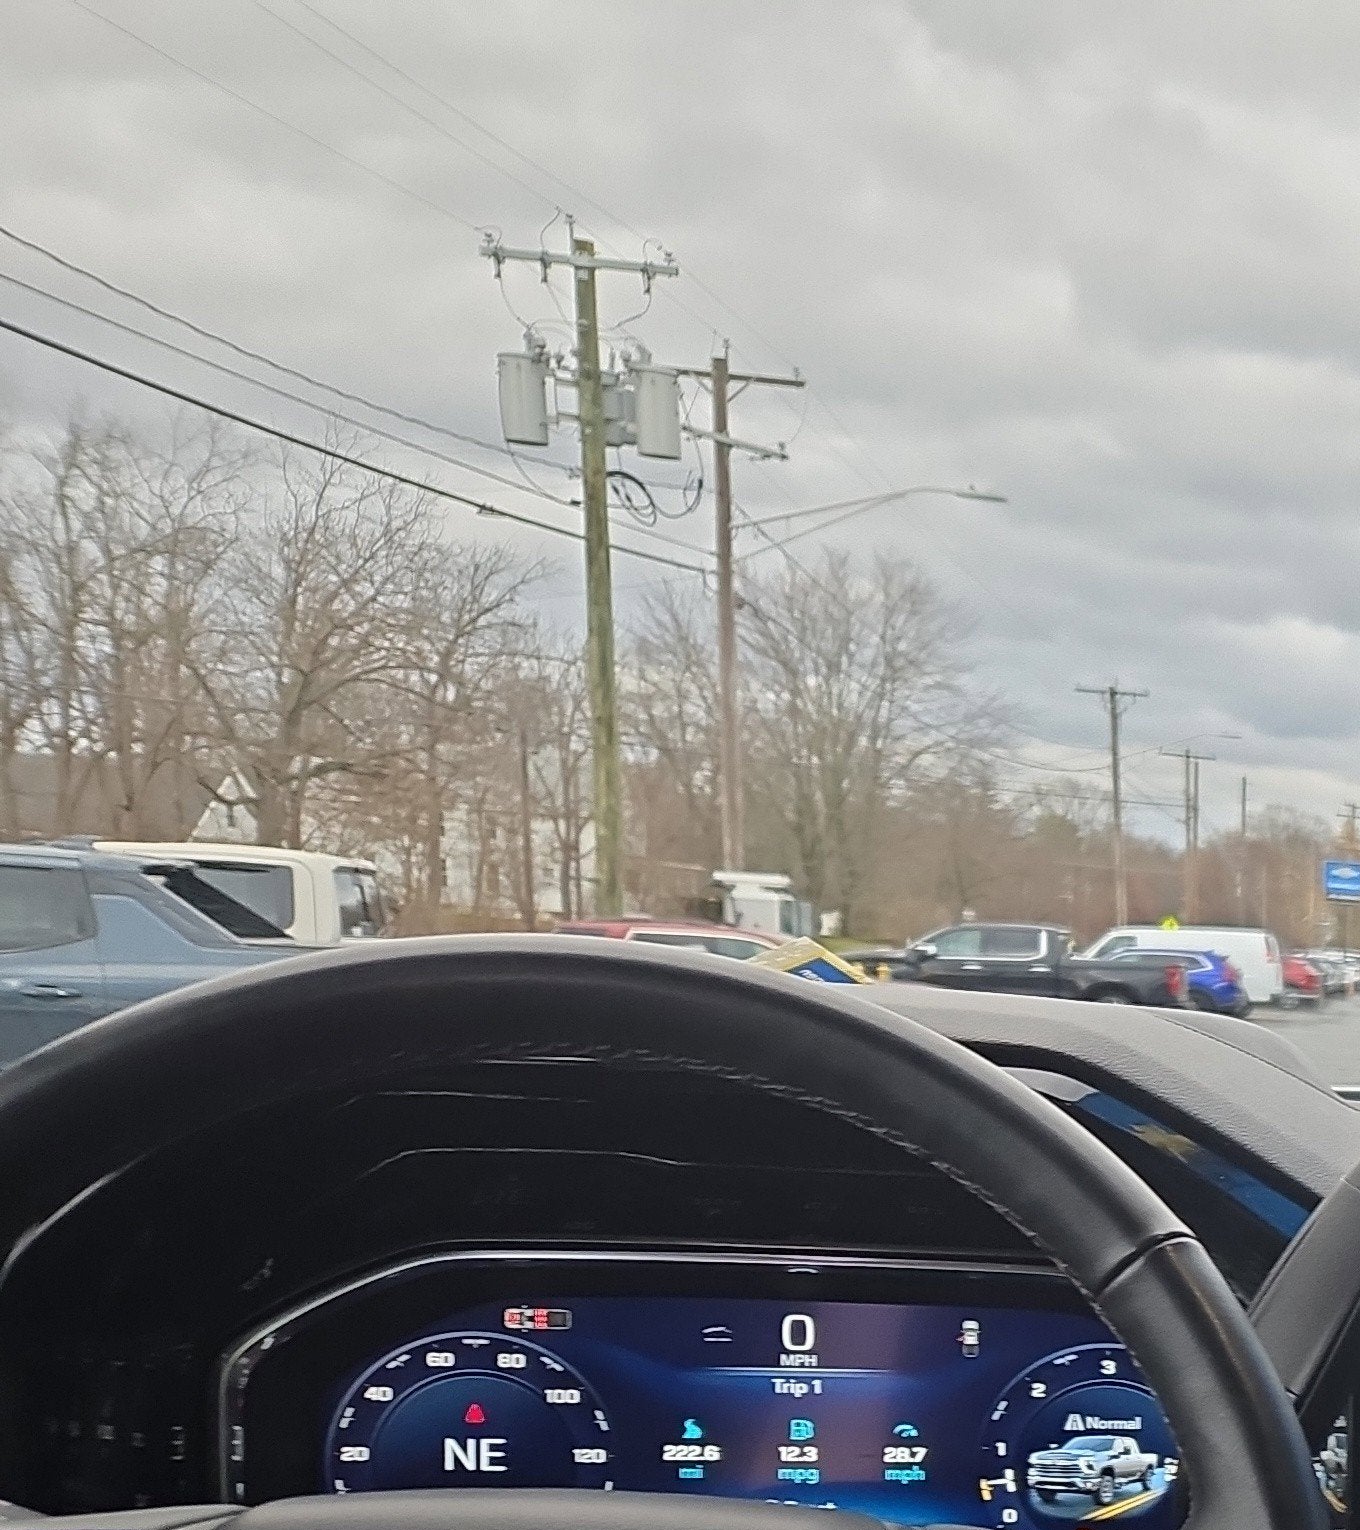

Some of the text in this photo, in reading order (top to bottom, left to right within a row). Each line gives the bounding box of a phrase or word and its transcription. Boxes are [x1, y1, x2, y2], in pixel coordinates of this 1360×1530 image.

[782, 1314, 815, 1351] 0
[426, 1352, 455, 1367] 60
[497, 1353, 526, 1368] 80
[779, 1354, 818, 1366] MPH
[1100, 1360, 1117, 1374] 3
[364, 1386, 394, 1401] 40
[771, 1378, 822, 1397] Trip 1
[1030, 1383, 1046, 1397] 2
[544, 1389, 580, 1404] 100
[1085, 1417, 1142, 1430] Normal
[340, 1447, 370, 1461] 20
[443, 1438, 508, 1471] NE
[572, 1448, 607, 1463] 120
[662, 1445, 721, 1461] 222.6
[778, 1446, 818, 1462] 12.3
[883, 1447, 928, 1463] 28.7
[995, 1442, 1006, 1456] 1
[679, 1465, 704, 1478] mi
[777, 1469, 819, 1484] mpg
[885, 1466, 925, 1484] mph
[1003, 1509, 1018, 1522] 0
